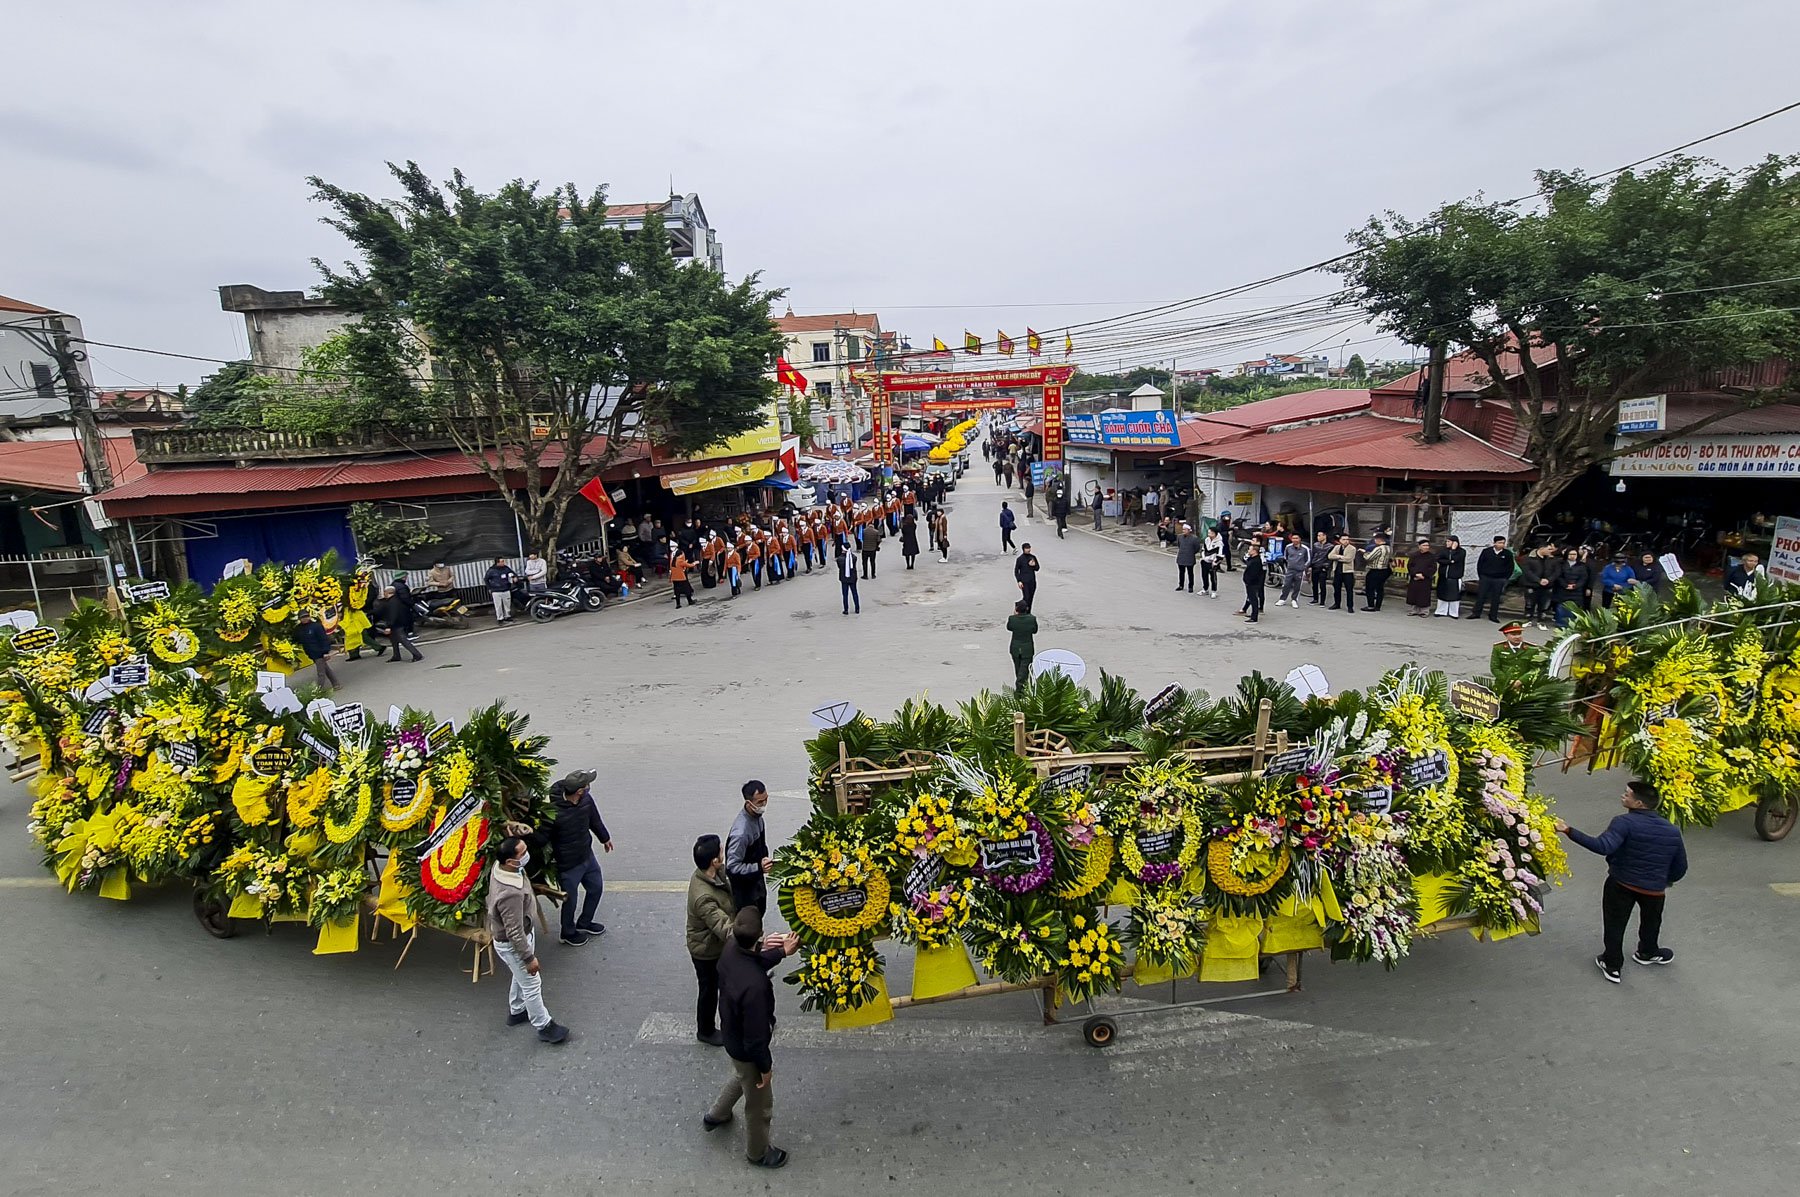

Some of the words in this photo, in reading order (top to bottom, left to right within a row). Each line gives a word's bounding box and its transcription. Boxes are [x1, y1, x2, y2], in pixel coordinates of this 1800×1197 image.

[1104, 421, 1126, 434] BÁNH
[1127, 419, 1152, 434] CUỐN
[1154, 418, 1174, 433] CHẢ
[1716, 445, 1728, 458] TA
[1731, 445, 1754, 458] THUI
[1755, 443, 1780, 458] RƠM
[1698, 460, 1715, 471] CÁC
